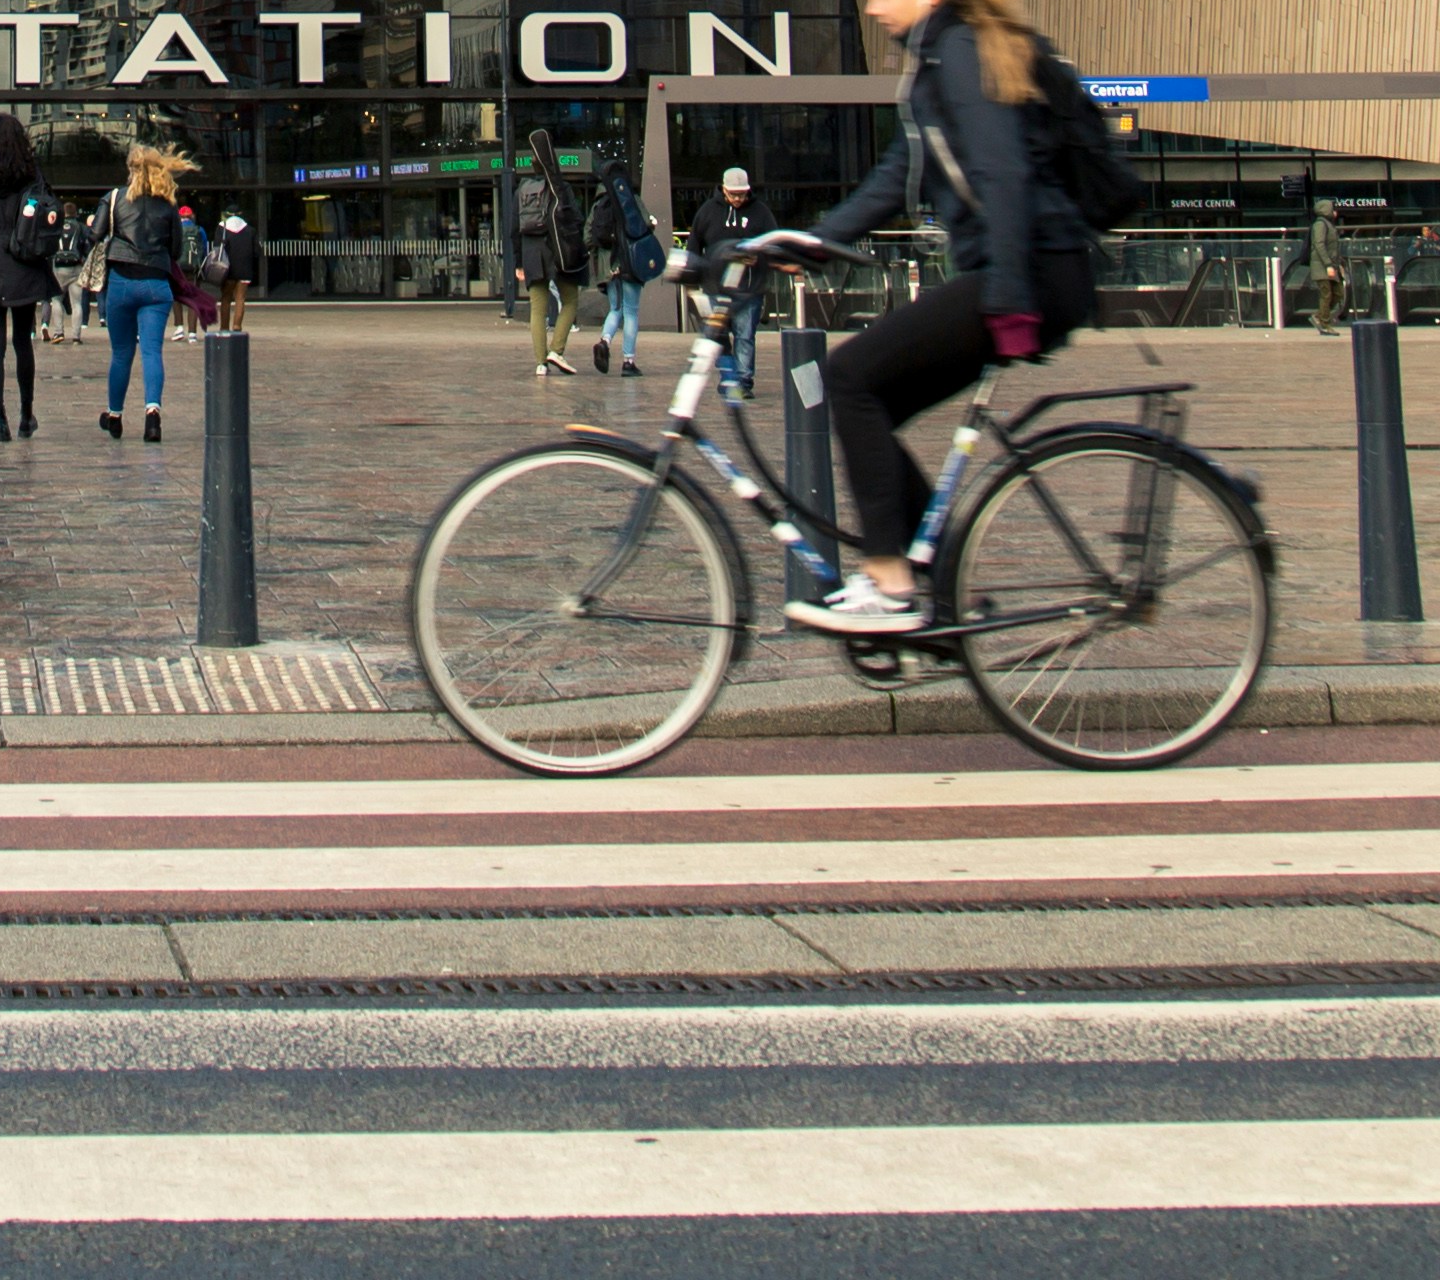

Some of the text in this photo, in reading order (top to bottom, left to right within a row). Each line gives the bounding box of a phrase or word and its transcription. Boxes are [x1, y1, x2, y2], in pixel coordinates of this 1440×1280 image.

[1089, 83, 1148, 97] Centraal
[1170, 199, 1236, 208] SERVICE CENTER
[1356, 198, 1387, 207] CENTER
